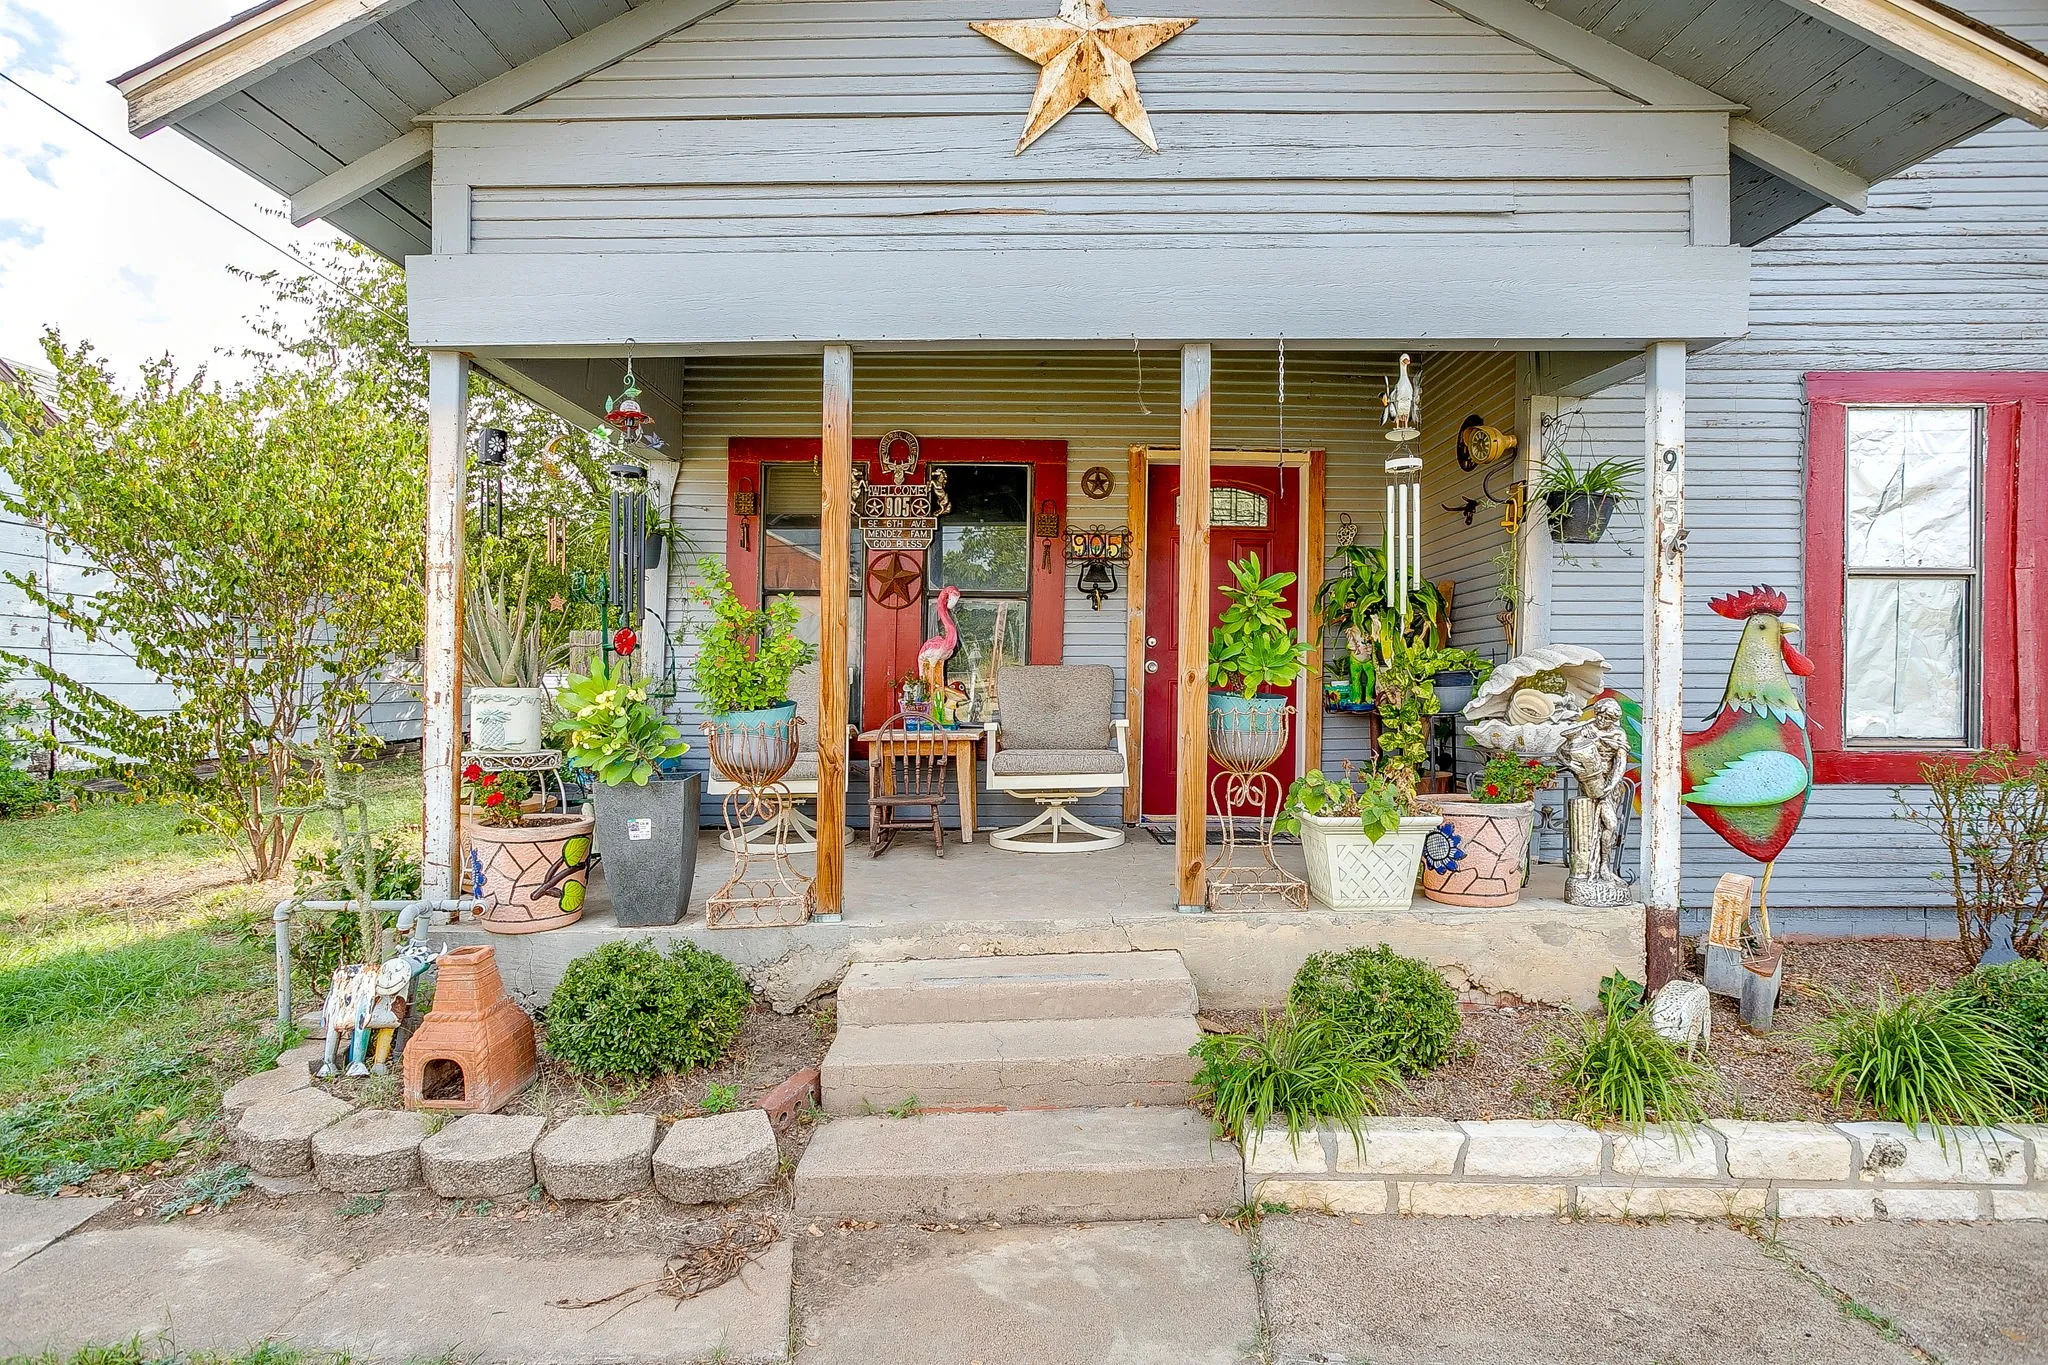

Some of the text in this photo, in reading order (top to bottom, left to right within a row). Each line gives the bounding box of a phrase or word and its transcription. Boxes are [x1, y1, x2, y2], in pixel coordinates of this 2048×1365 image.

[870, 485, 925, 496] WELCOME
[886, 497, 910, 517] 905
[867, 520, 929, 528] SE 6TH AVE.
[868, 530, 903, 538] MENDEZ
[873, 540, 923, 548] GOD BLESS
[1073, 534, 1120, 558] 905
